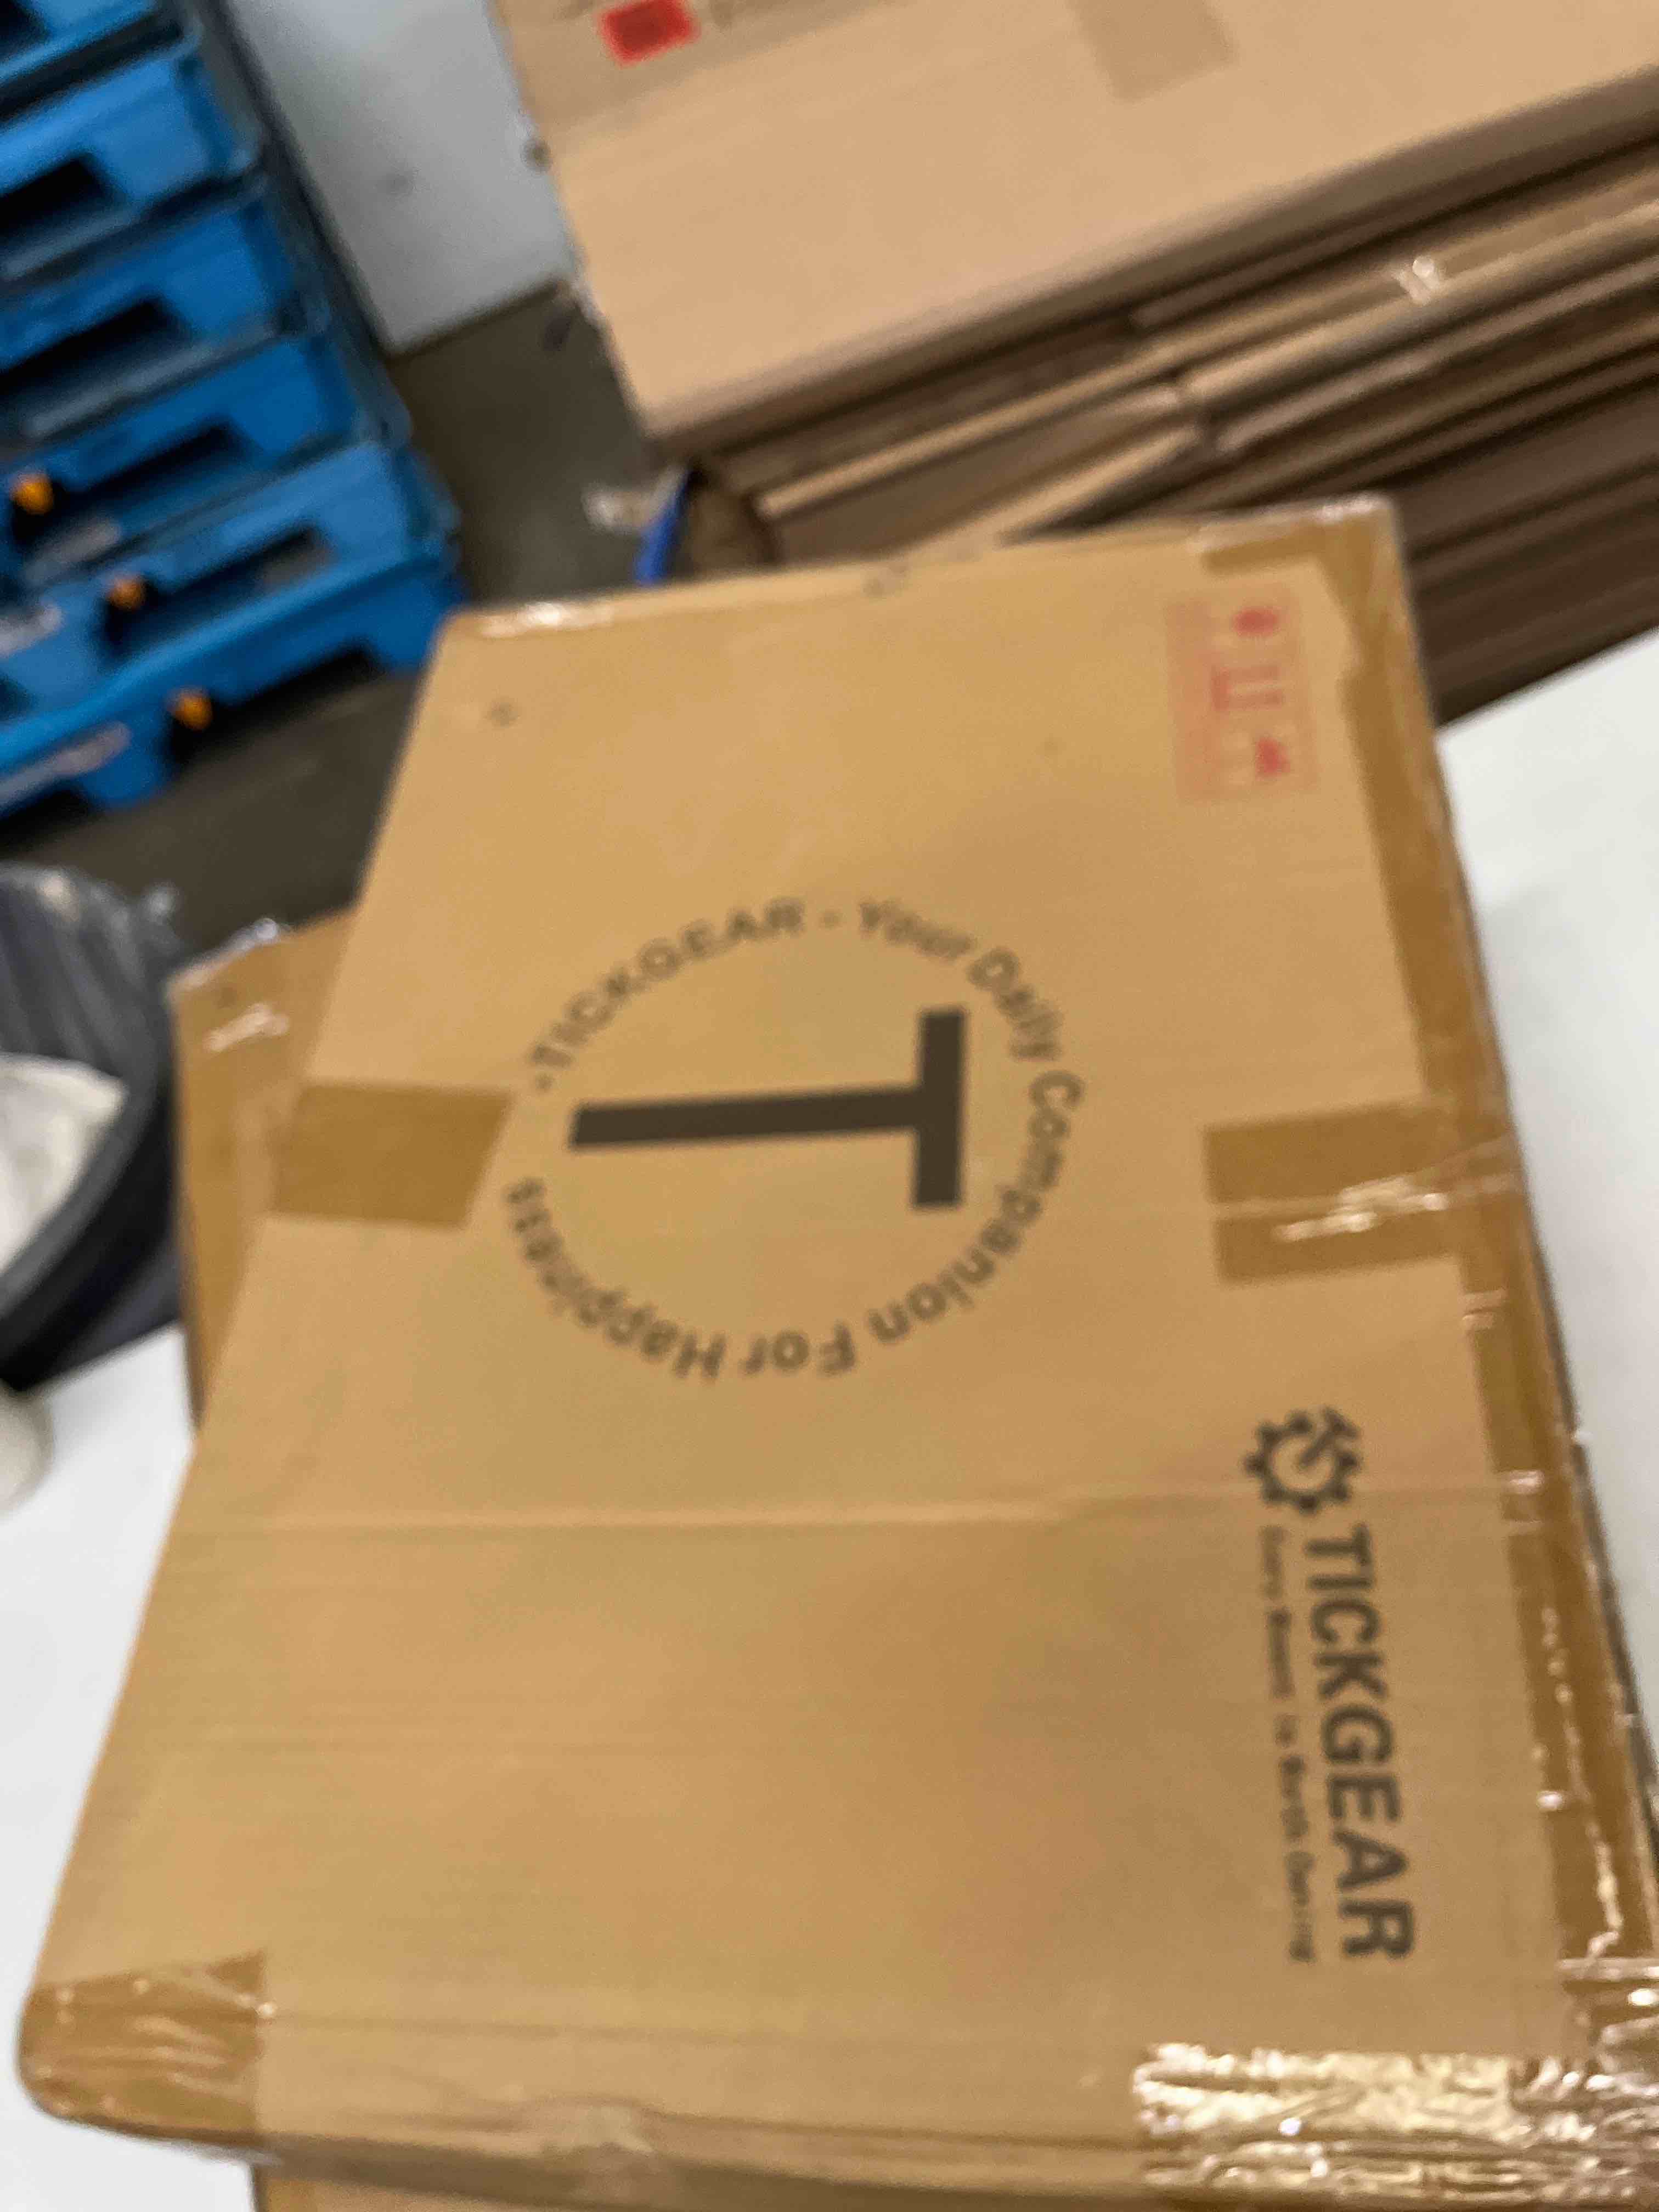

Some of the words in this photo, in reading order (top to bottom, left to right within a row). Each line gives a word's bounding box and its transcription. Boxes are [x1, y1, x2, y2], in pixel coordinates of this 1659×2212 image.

[531, 896, 804, 1069] TICKGEAR
[858, 898, 975, 961] Your
[568, 1004, 966, 1210] T
[867, 1070, 1084, 1344] Companion
[741, 1321, 856, 1377] For
[1305, 1523, 1415, 1960] TICKGEAR
